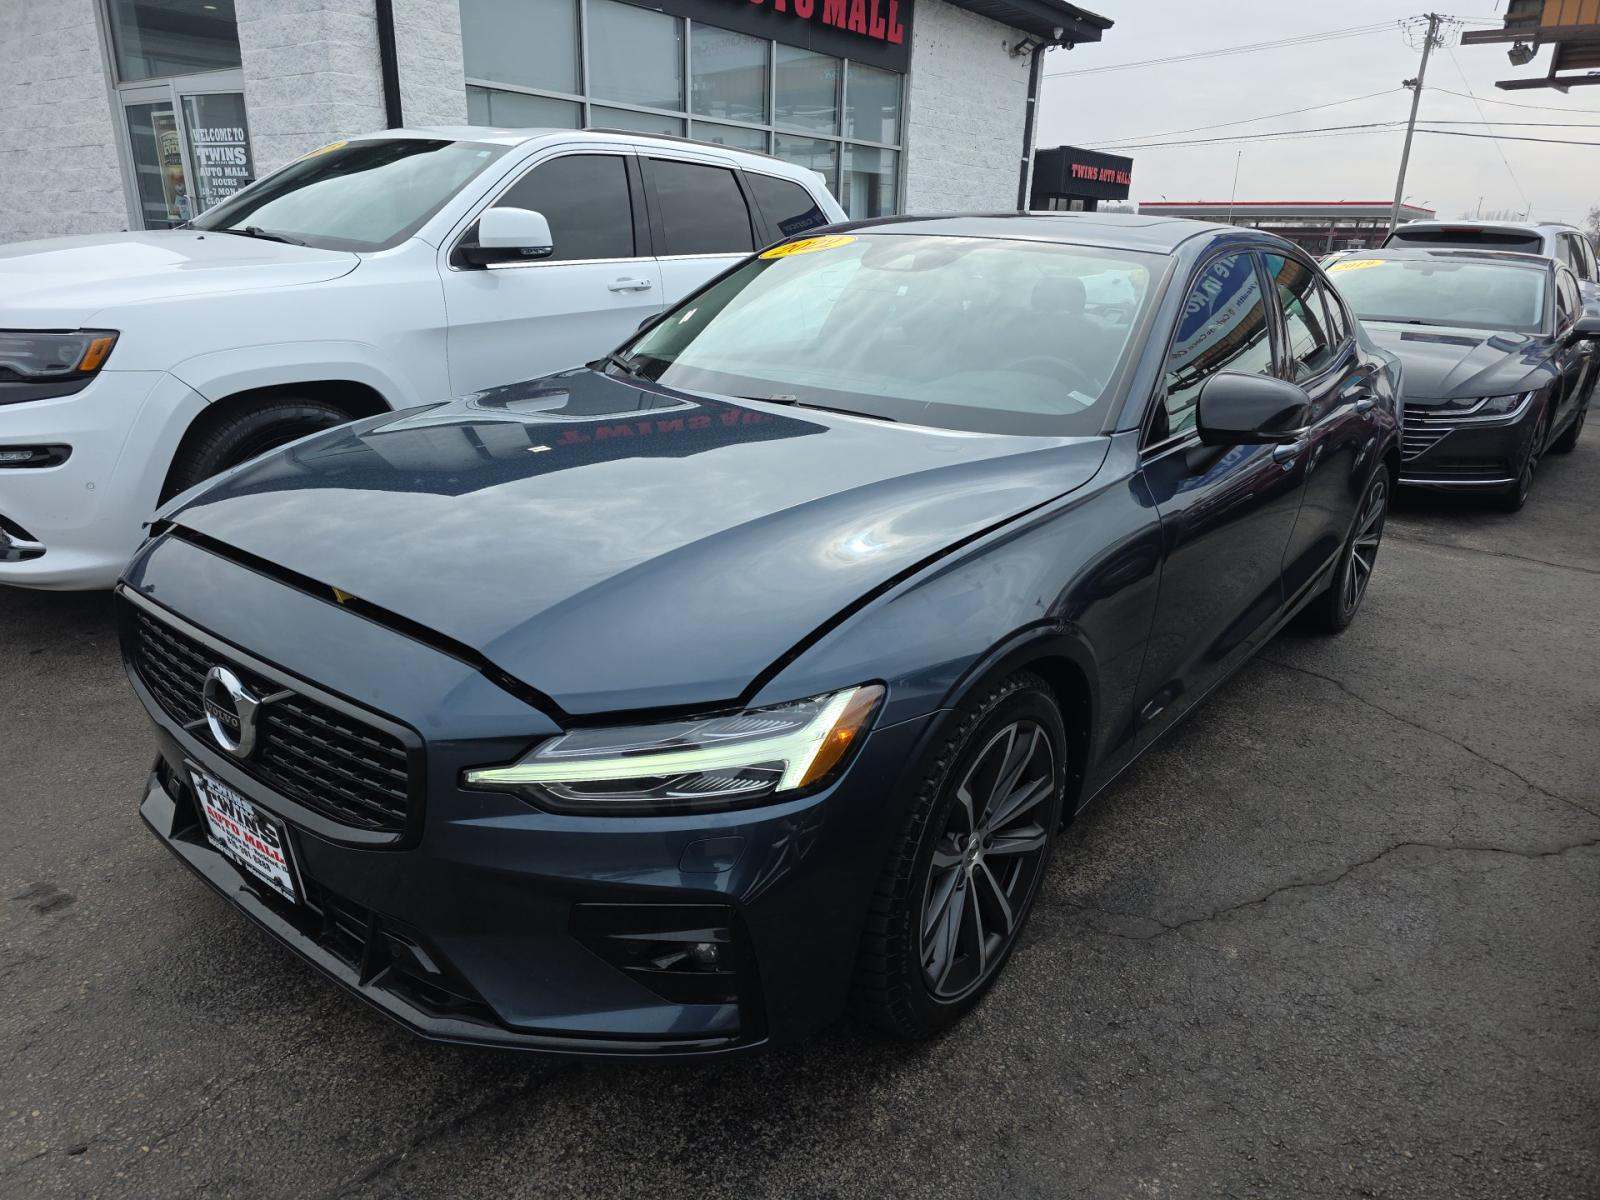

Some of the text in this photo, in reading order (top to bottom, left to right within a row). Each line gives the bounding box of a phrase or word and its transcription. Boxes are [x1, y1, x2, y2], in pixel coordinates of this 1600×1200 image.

[822, 0, 905, 45] MALL
[193, 127, 244, 142] WELCOME TO
[197, 147, 247, 165] TWINS
[200, 167, 249, 177] AUTO MALL
[212, 178, 238, 186] HOURS
[1071, 163, 1132, 185] TWINS AUTO MALL
[202, 784, 280, 849] TWINS
[206, 804, 240, 836] AUTO
[243, 831, 286, 864] MALL
